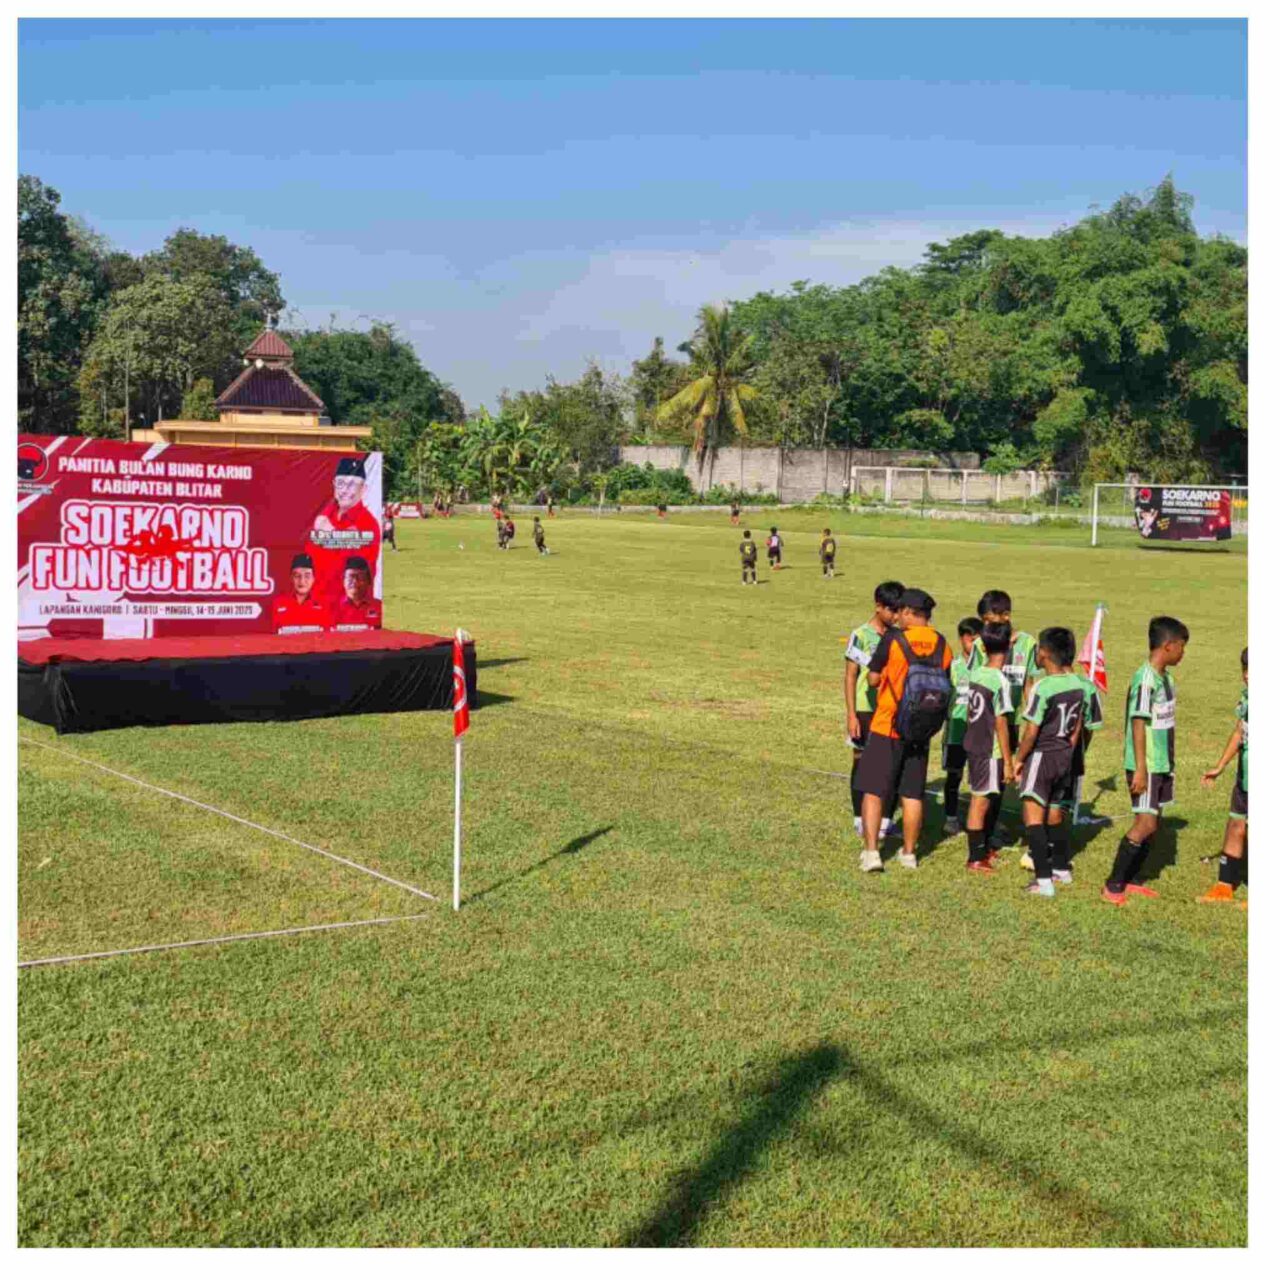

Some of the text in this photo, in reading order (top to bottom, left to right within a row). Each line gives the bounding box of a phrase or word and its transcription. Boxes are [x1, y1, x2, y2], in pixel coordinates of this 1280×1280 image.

[58, 457, 253, 480] PANITIA BULAN BUNG KARNO
[91, 478, 223, 498] KABUPATEN BLITAR
[1161, 489, 1221, 501] SOEKARNO
[67, 504, 244, 548] SOEKARNO
[34, 548, 271, 591] FUN FOOTBALL
